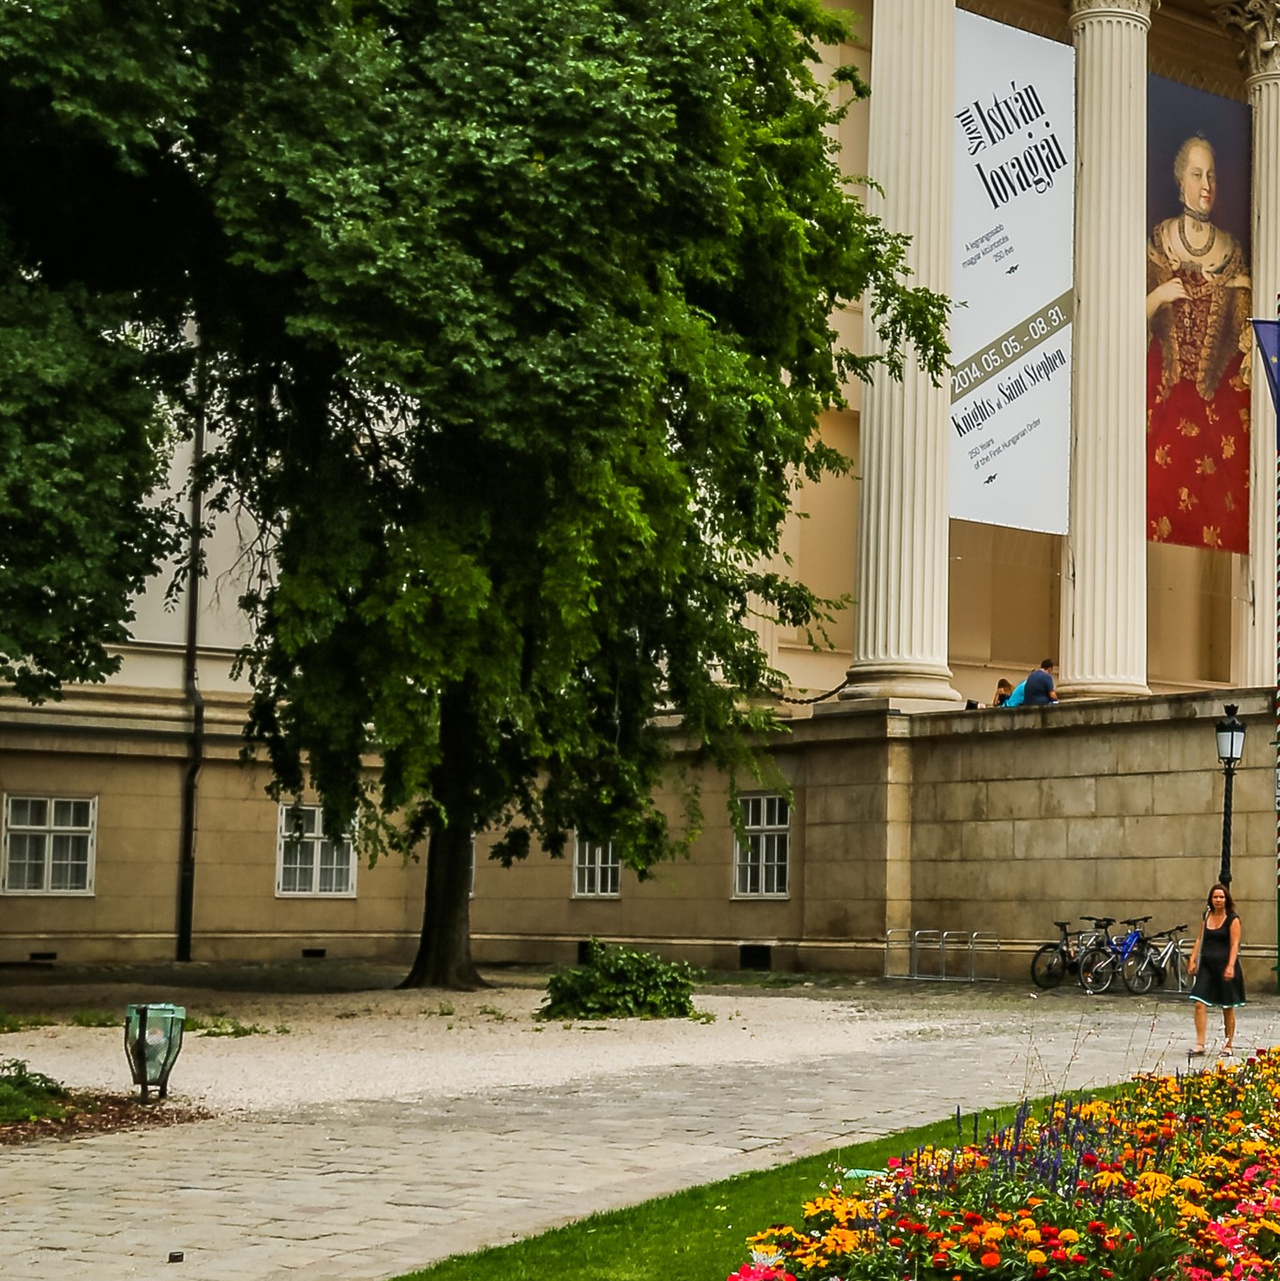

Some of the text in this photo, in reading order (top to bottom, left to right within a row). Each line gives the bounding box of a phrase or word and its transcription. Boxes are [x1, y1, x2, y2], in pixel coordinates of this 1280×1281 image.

[954, 107, 987, 156] Szent
[973, 81, 1046, 146] István
[975, 121, 1068, 210] lovagjai
[950, 397, 996, 438] Knights
[997, 371, 1028, 405] Saint
[1023, 348, 1067, 387] Stephen
[951, 362, 984, 394] 2014.
[981, 348, 1004, 372] 05.
[1001, 335, 1024, 358] 05.
[1028, 317, 1051, 340] 08.
[1047, 306, 1067, 326] 31.
